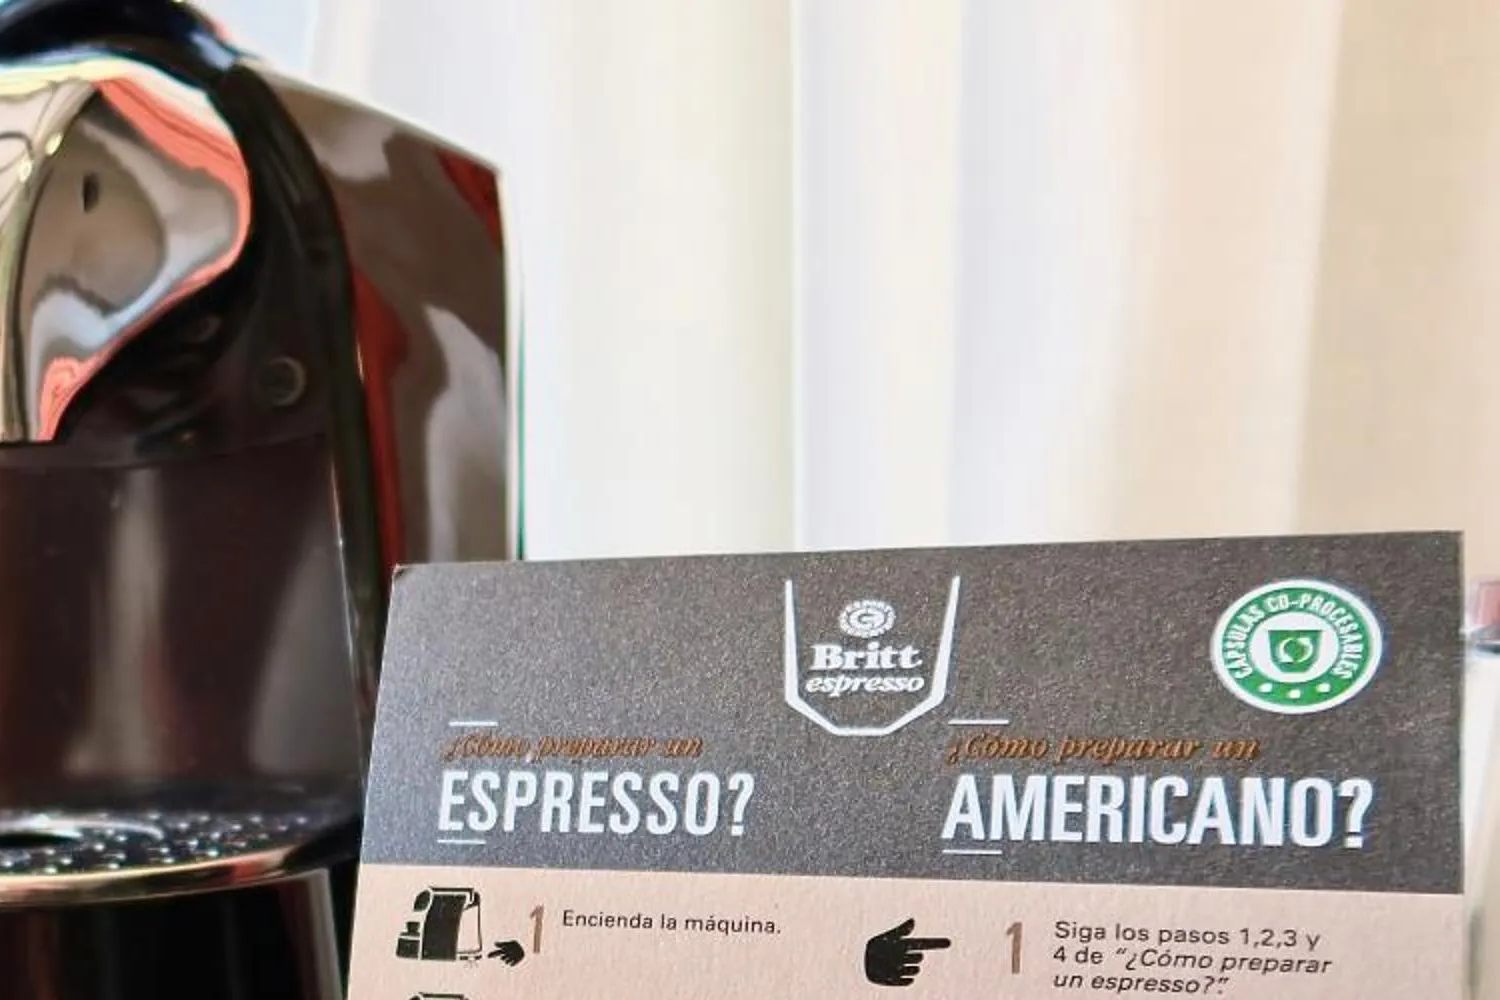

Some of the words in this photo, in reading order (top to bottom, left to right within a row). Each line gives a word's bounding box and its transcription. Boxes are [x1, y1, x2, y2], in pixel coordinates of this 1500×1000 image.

[809, 641, 924, 670] Britt
[805, 674, 925, 698] espresso
[1054, 736, 1199, 766] preparar
[1211, 738, 1260, 761] un
[437, 770, 755, 836] ESPRESSO?
[941, 773, 1373, 849] AMERICANO?
[529, 904, 545, 954] 1
[562, 909, 653, 929] Encienda
[660, 913, 677, 931] la
[684, 914, 782, 936] máquina.
[1054, 921, 1106, 944] Siga
[1115, 923, 1149, 942] los
[1158, 928, 1230, 947] pasos
[1239, 928, 1298, 949] 1,2,3
[1306, 932, 1321, 951] y
[1004, 921, 1024, 975] 1
[1053, 946, 1066, 963] 4
[1074, 947, 1103, 965] de
[1220, 954, 1332, 976] preparar
[1053, 974, 1083, 989] un
